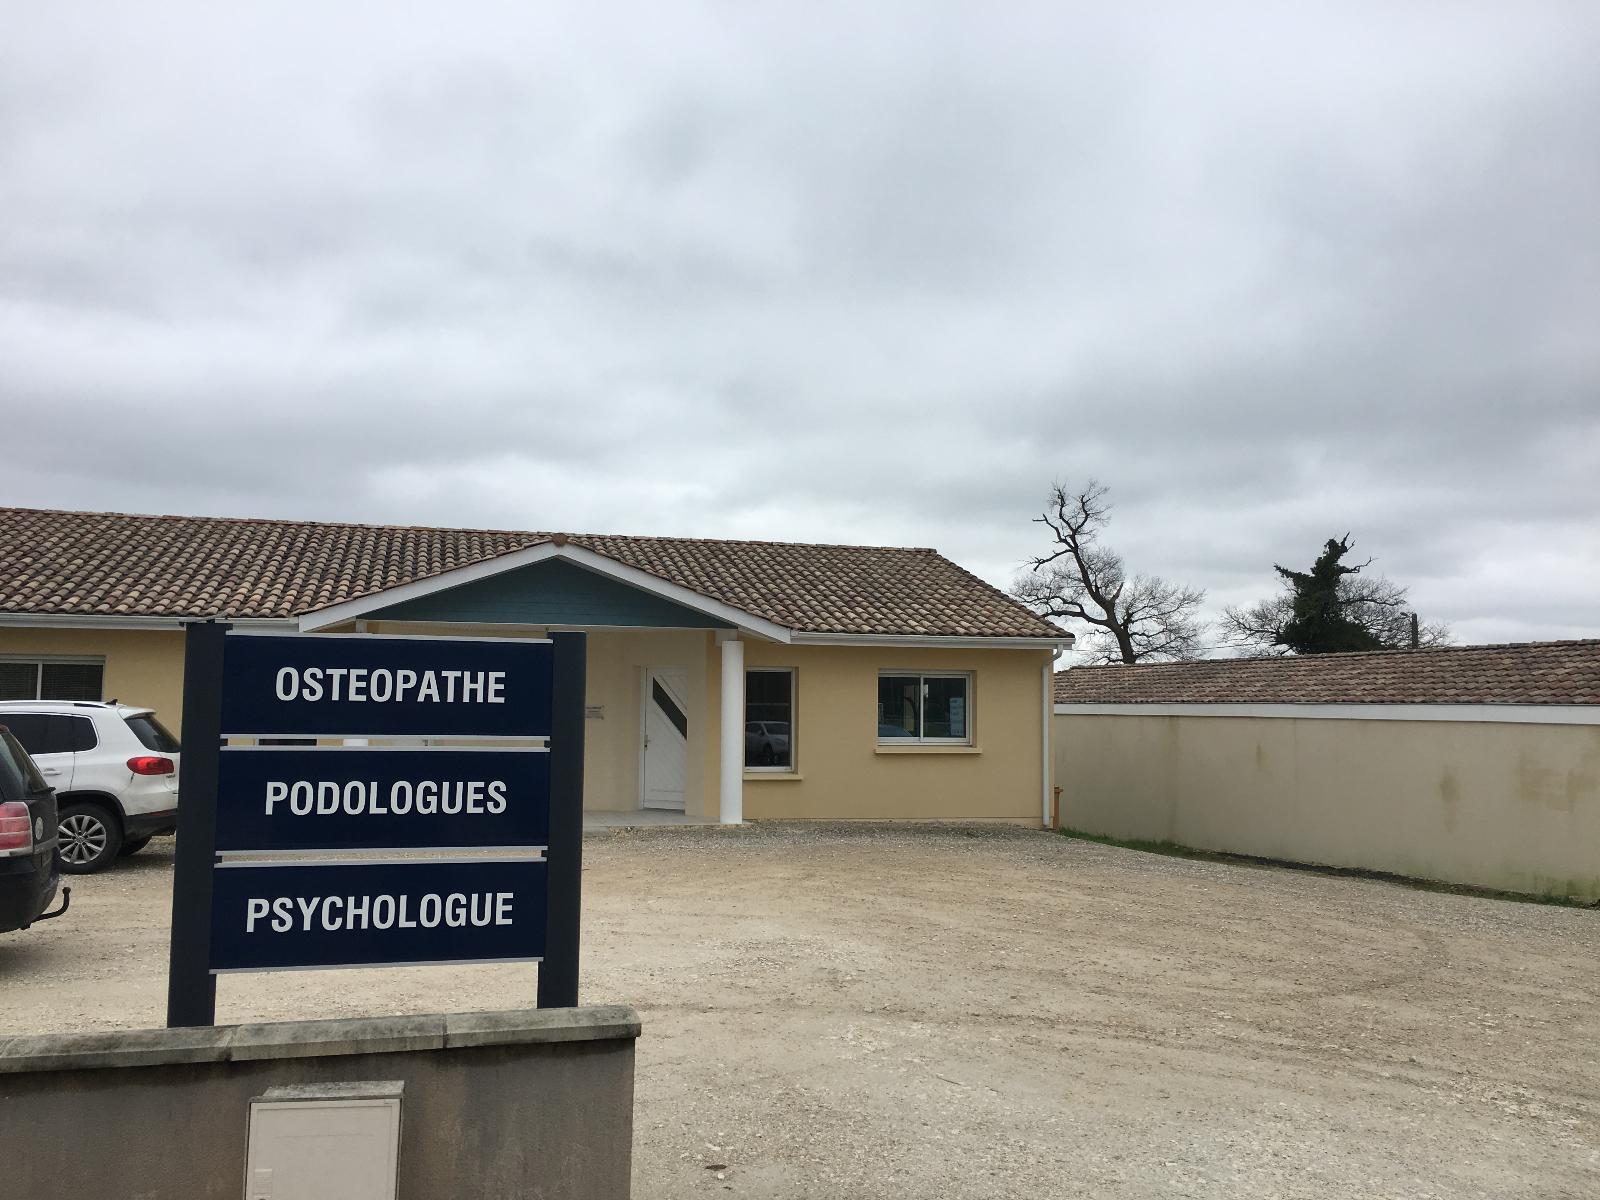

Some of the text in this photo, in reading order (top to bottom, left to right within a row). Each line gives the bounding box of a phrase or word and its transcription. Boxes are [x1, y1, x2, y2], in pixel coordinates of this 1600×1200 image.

[275, 667, 506, 704] OSTEOPATHE
[265, 780, 507, 816] PODOLOGUES
[246, 892, 514, 933] PSYCHOLOGUE
